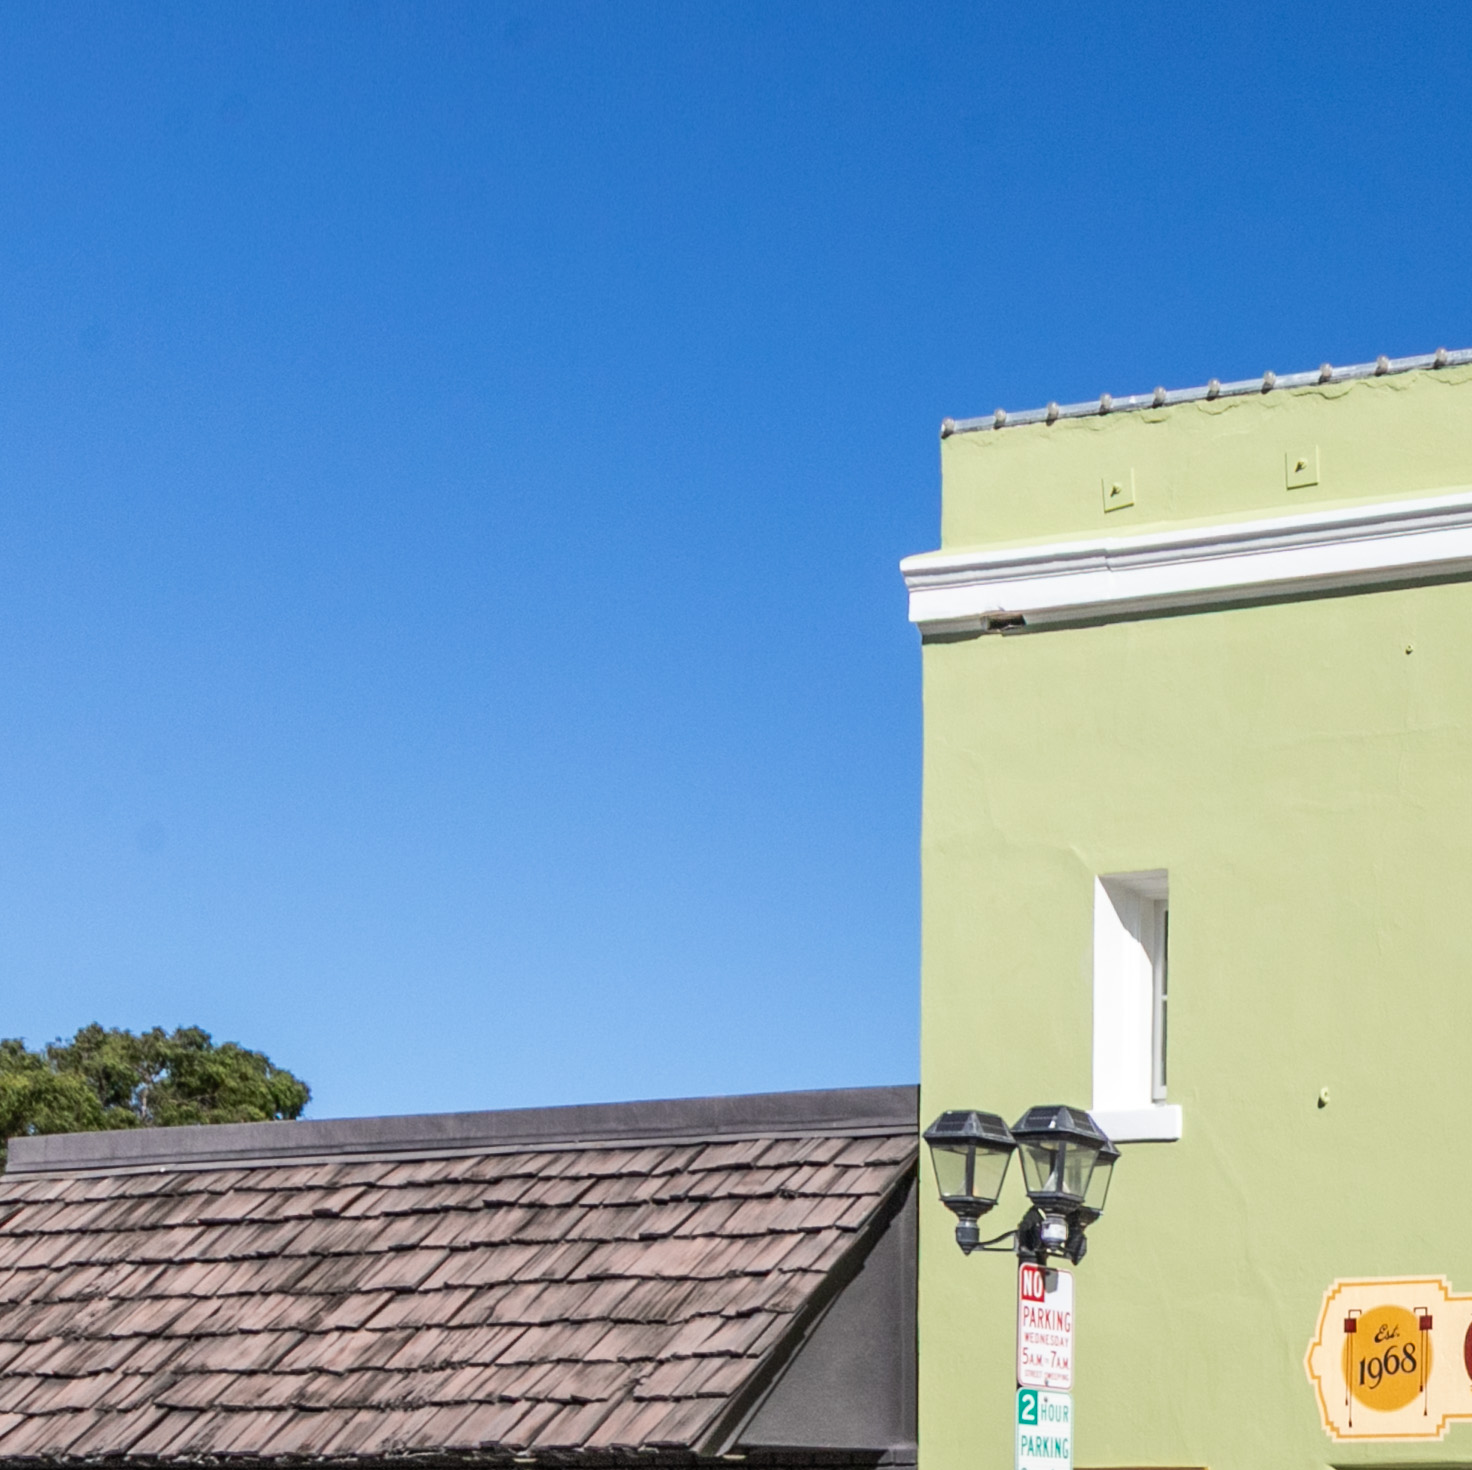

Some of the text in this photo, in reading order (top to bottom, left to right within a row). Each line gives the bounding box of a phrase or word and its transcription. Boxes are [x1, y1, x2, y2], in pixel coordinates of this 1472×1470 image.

[1023, 1269, 1044, 1299] NO
[1022, 1305, 1071, 1333] PARKING
[1374, 1323, 1400, 1343] Est.
[1023, 1332, 1070, 1348] WEDNESDAY
[1358, 1342, 1417, 1390] 1968
[1021, 1393, 1069, 1423] 2 HOUR
[1021, 1434, 1069, 1460] PARKING
